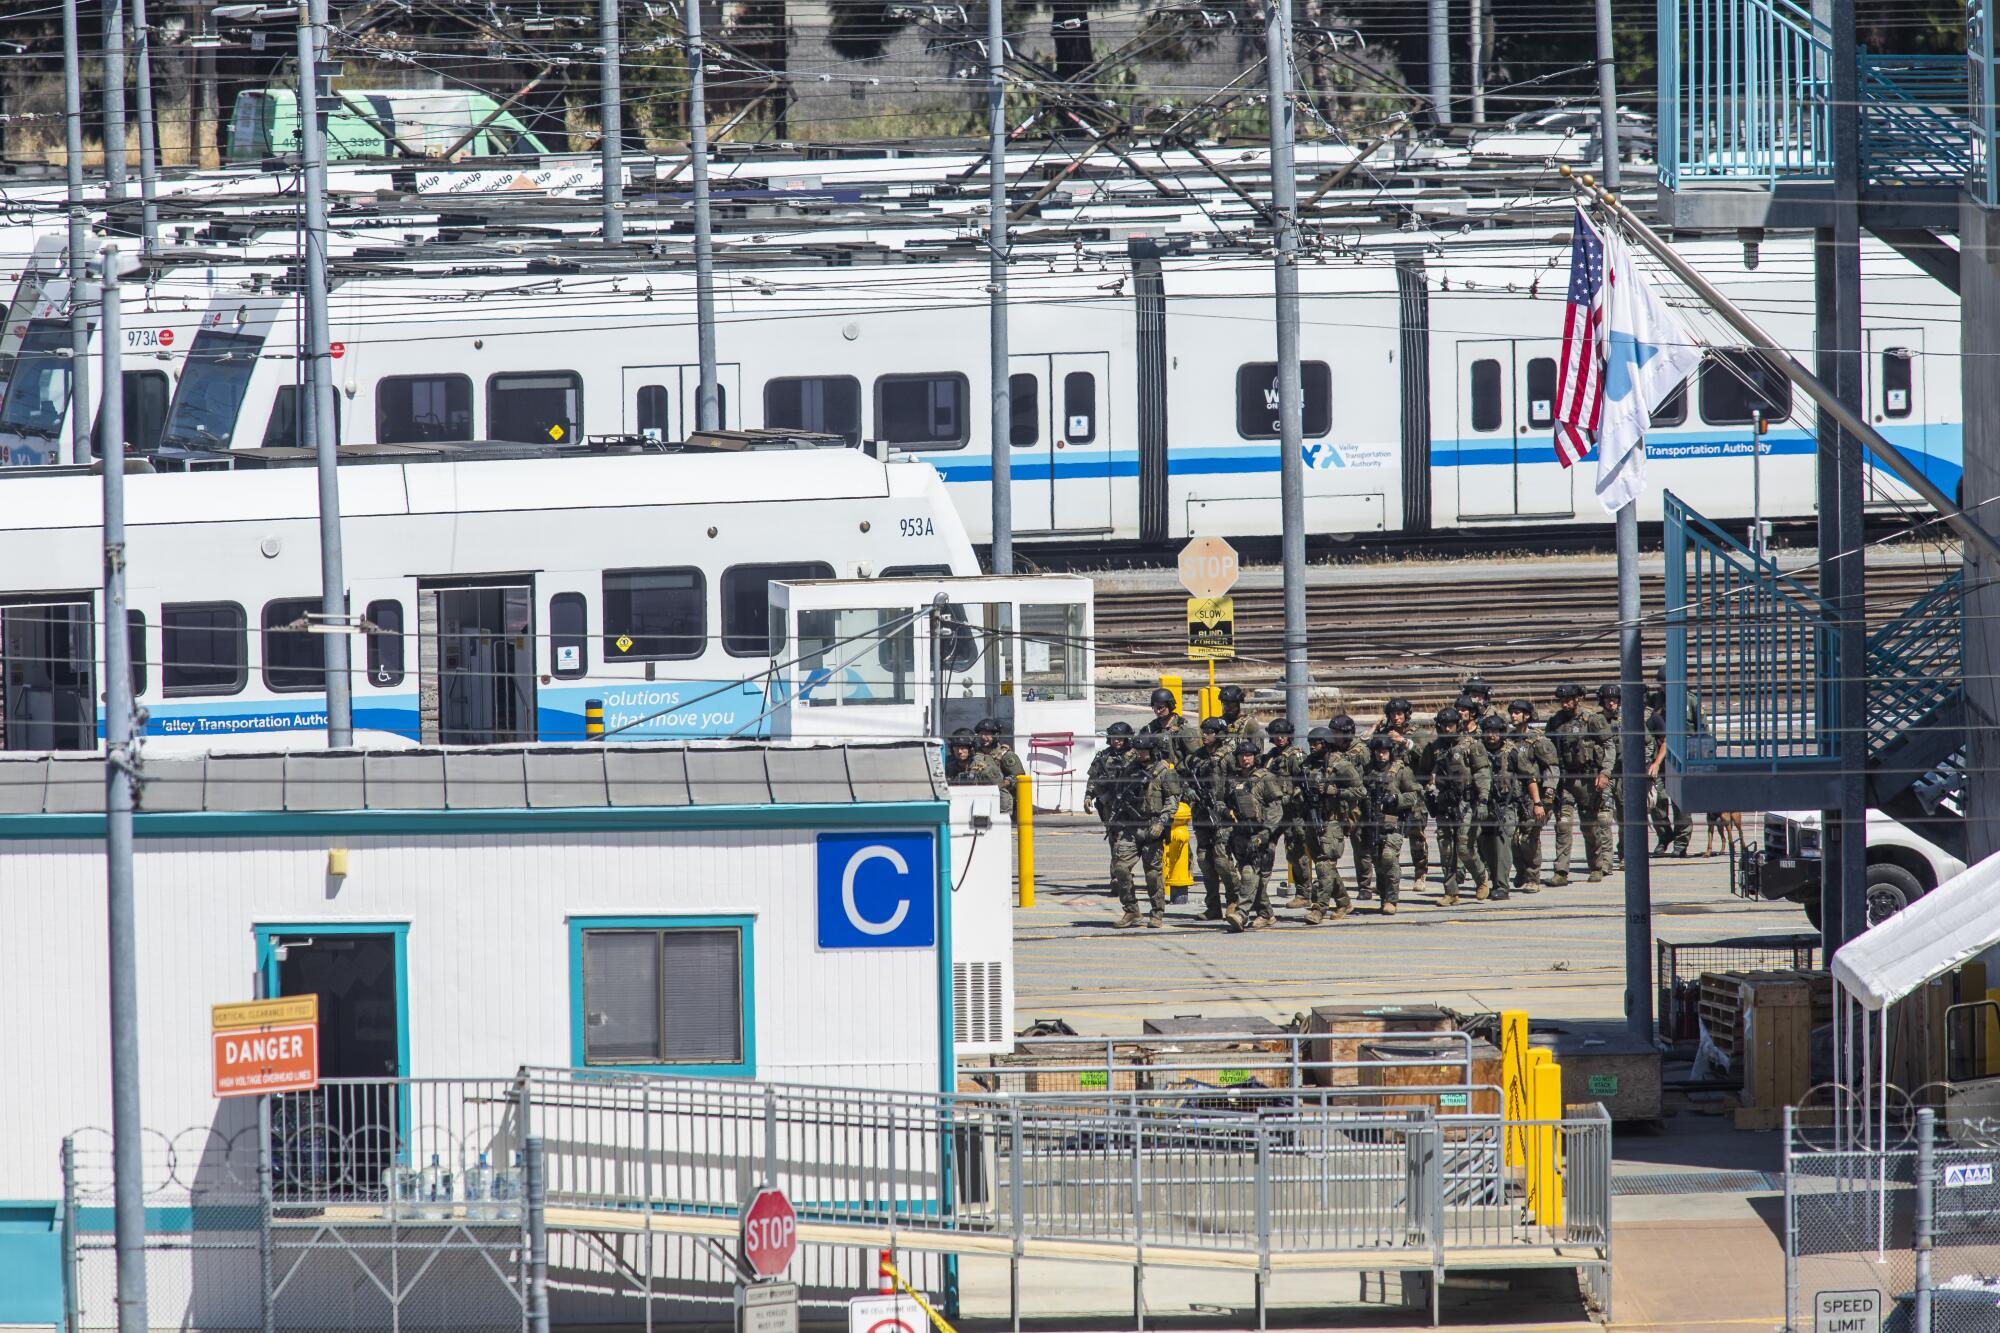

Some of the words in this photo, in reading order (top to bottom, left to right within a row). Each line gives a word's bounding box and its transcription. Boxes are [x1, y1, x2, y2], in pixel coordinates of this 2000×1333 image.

[550, 172, 583, 197] ClickUp
[128, 330, 158, 347] 973A
[1339, 443, 1359, 451] Valley
[1345, 450, 1392, 460] Transportation
[1646, 445, 1721, 458] Transportation
[1723, 441, 1773, 454] Authoity
[1350, 460, 1382, 468] Authority
[900, 517, 935, 537] 953A
[1183, 555, 1235, 579] STOP
[1199, 609, 1222, 619] SLOW
[1198, 629, 1224, 638] BLIND
[198, 716, 291, 732] Transportation
[610, 712, 646, 728] that
[701, 711, 735, 729] you
[842, 845, 910, 936] C
[225, 1035, 304, 1065] DANGER
[748, 1215, 794, 1252] STOP
[1823, 1299, 1873, 1314] SPEED
[1829, 1318, 1866, 1332] LIMIT
